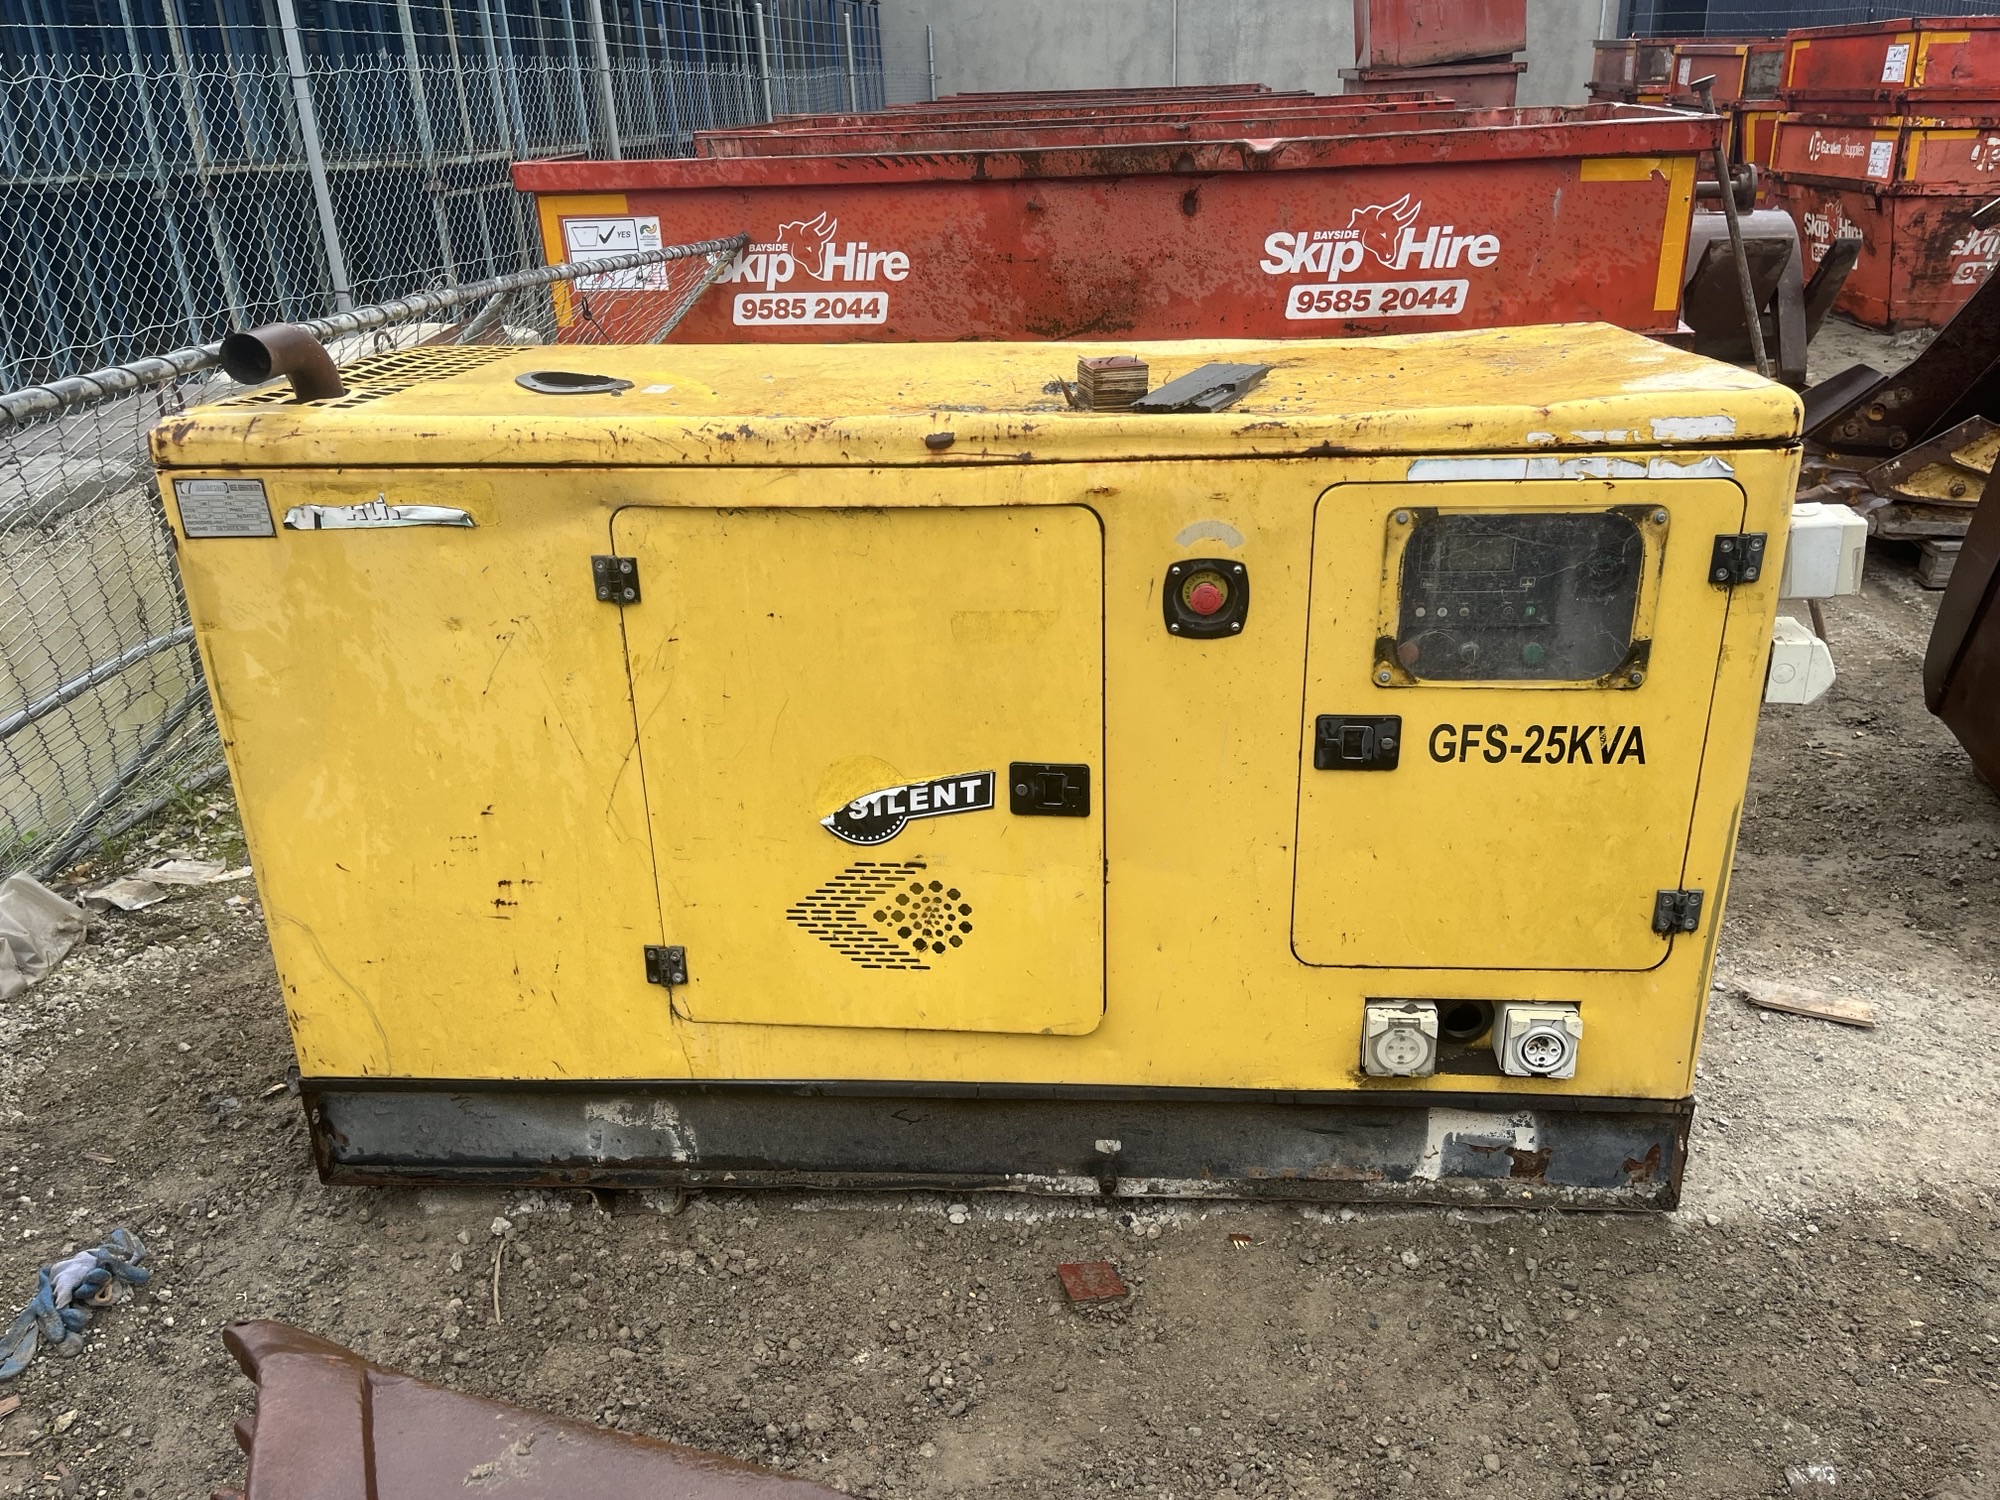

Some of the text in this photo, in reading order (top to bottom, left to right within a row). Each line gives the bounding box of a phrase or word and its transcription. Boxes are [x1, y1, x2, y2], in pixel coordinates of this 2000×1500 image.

[616, 230, 631, 239] YES
[749, 243, 788, 253] BAYSIDE
[1313, 229, 1360, 241] BAYSIDE
[823, 241, 911, 282] Hire
[1259, 225, 1501, 282] Skip Hire
[741, 297, 881, 320] 9585 2044
[1296, 286, 1458, 313] 9585 2044
[1428, 723, 1647, 765] GFS-25KVA
[848, 778, 982, 820] SILENT
